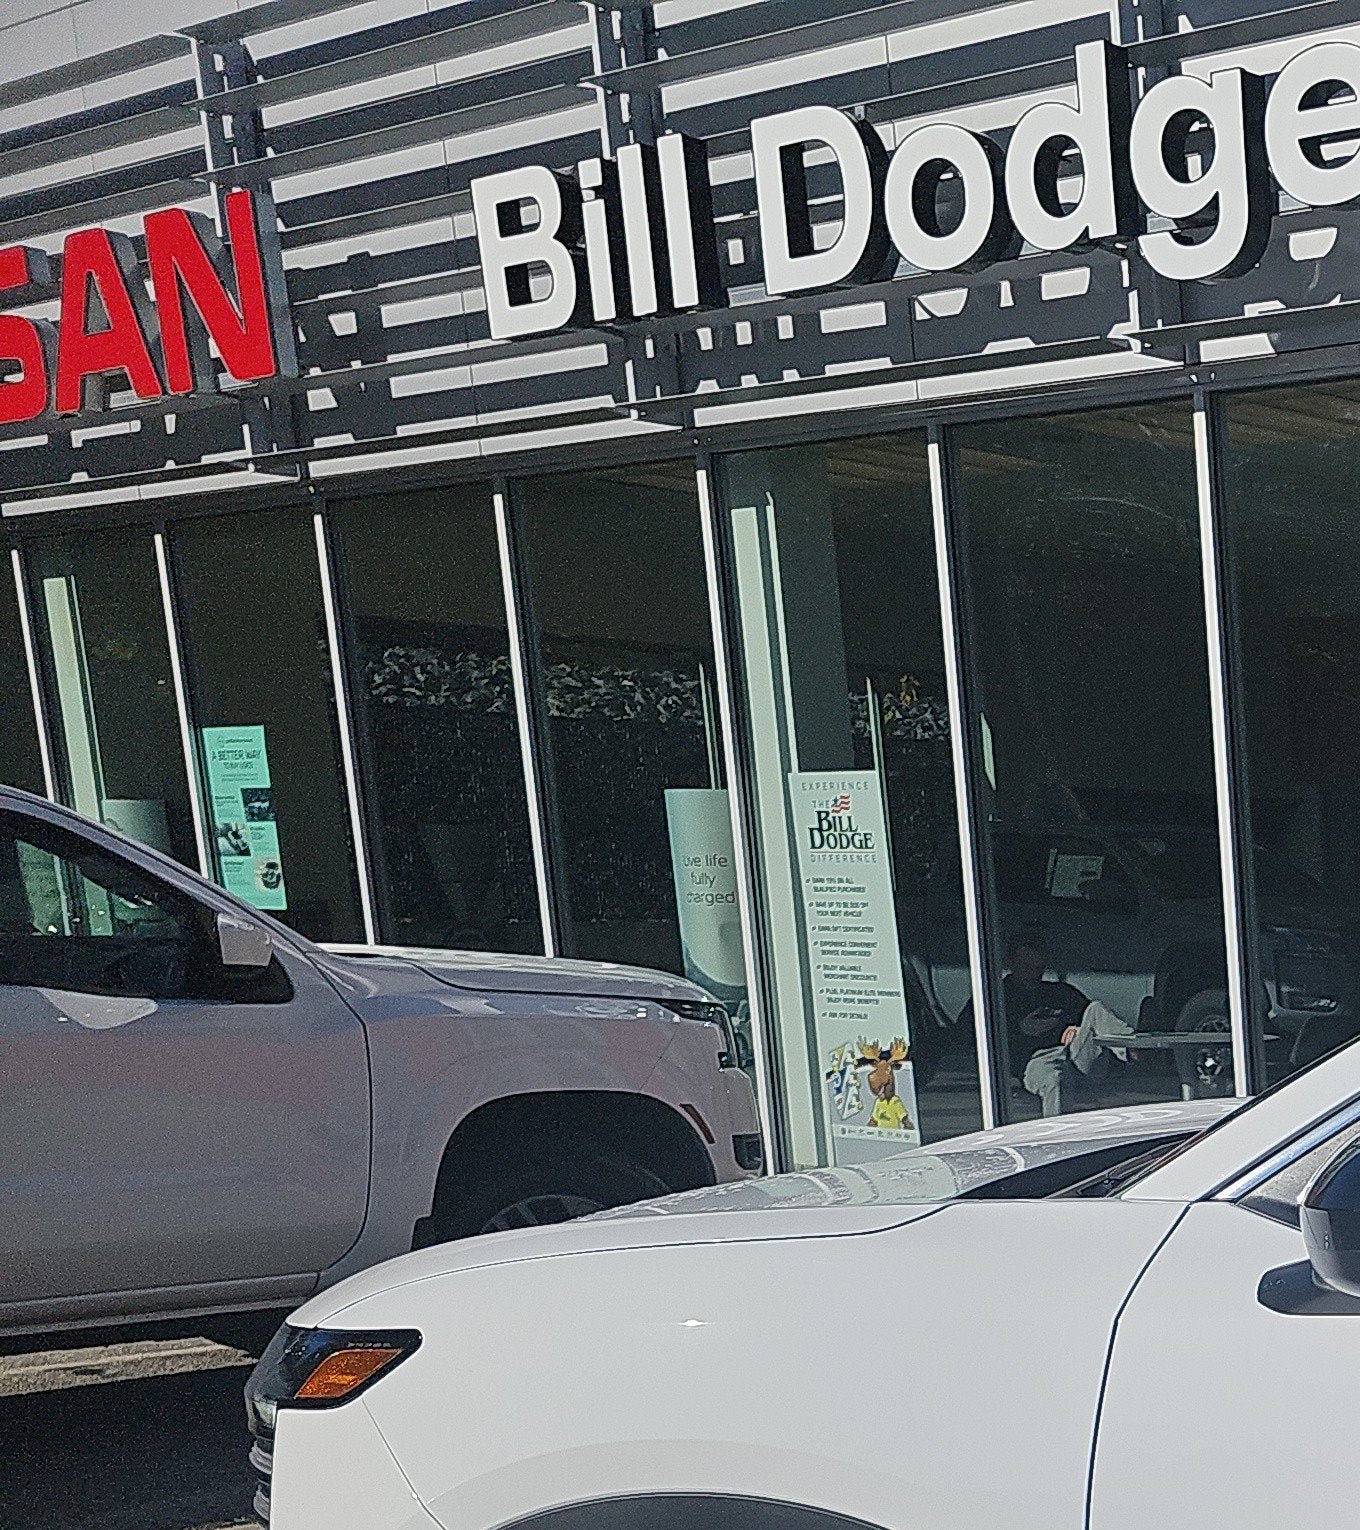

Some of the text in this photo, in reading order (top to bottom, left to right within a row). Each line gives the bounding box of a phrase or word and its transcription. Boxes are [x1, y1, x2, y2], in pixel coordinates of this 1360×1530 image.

[470, 131, 698, 340] Bill
[801, 781, 869, 791] EXPERIENCE
[812, 800, 830, 809] THE
[815, 811, 859, 833] BILL
[808, 827, 876, 849] DODGE
[705, 854, 728, 867] life
[810, 854, 877, 864] DIFFERENCE
